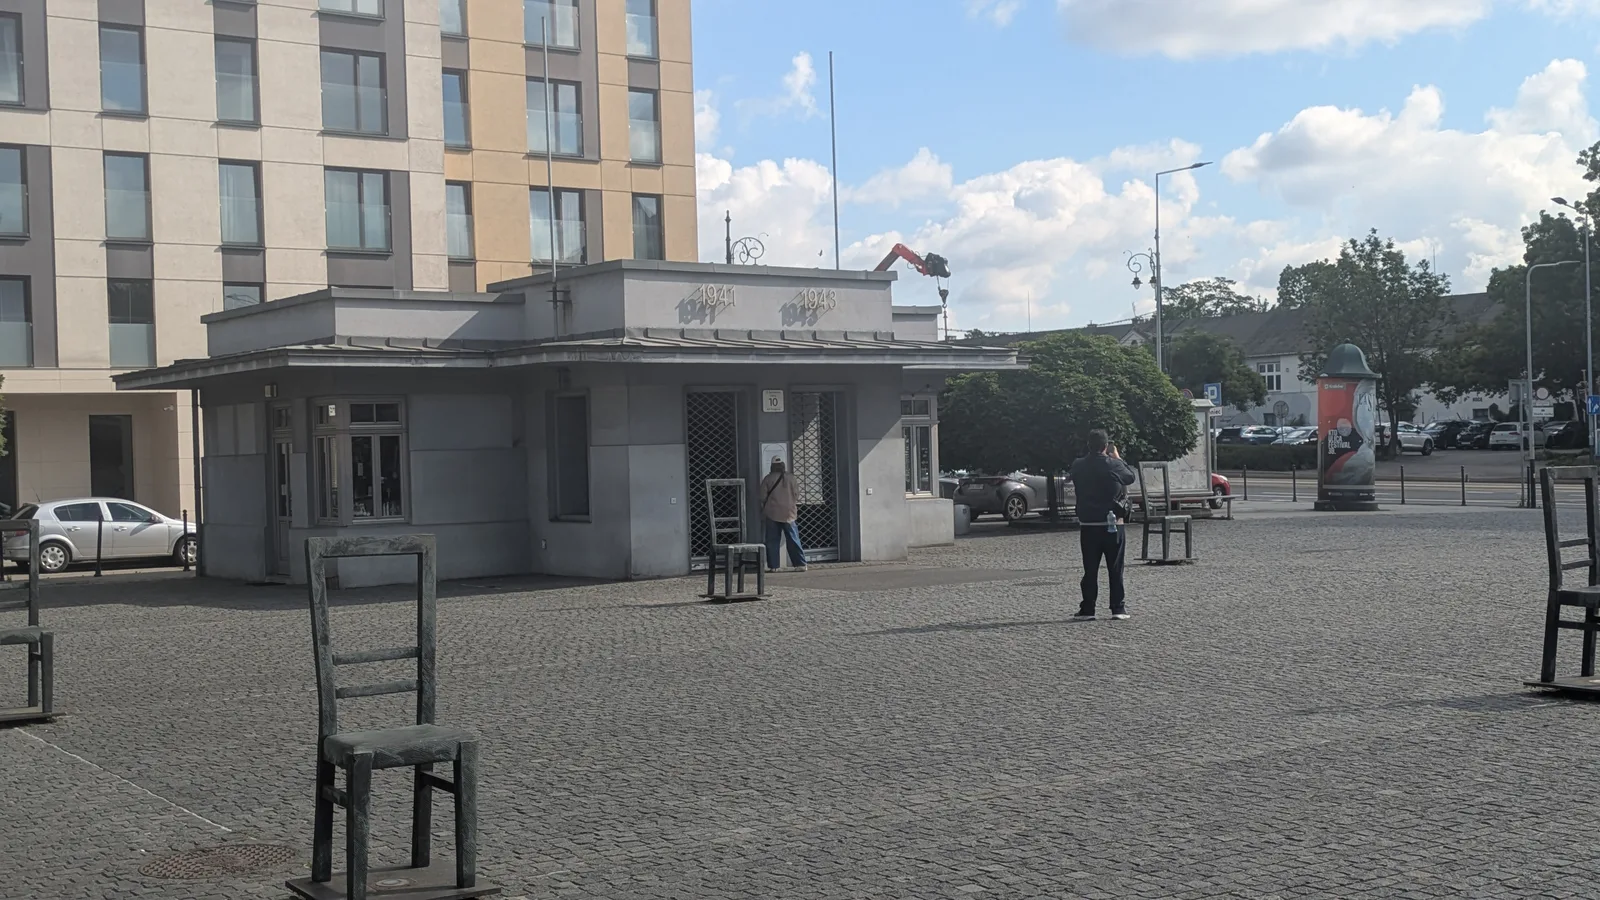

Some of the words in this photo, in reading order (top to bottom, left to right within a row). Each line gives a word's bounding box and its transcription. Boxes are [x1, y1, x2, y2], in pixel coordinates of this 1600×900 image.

[700, 284, 736, 306] 1941
[801, 288, 837, 310] 1943
[769, 397, 778, 407] 10
